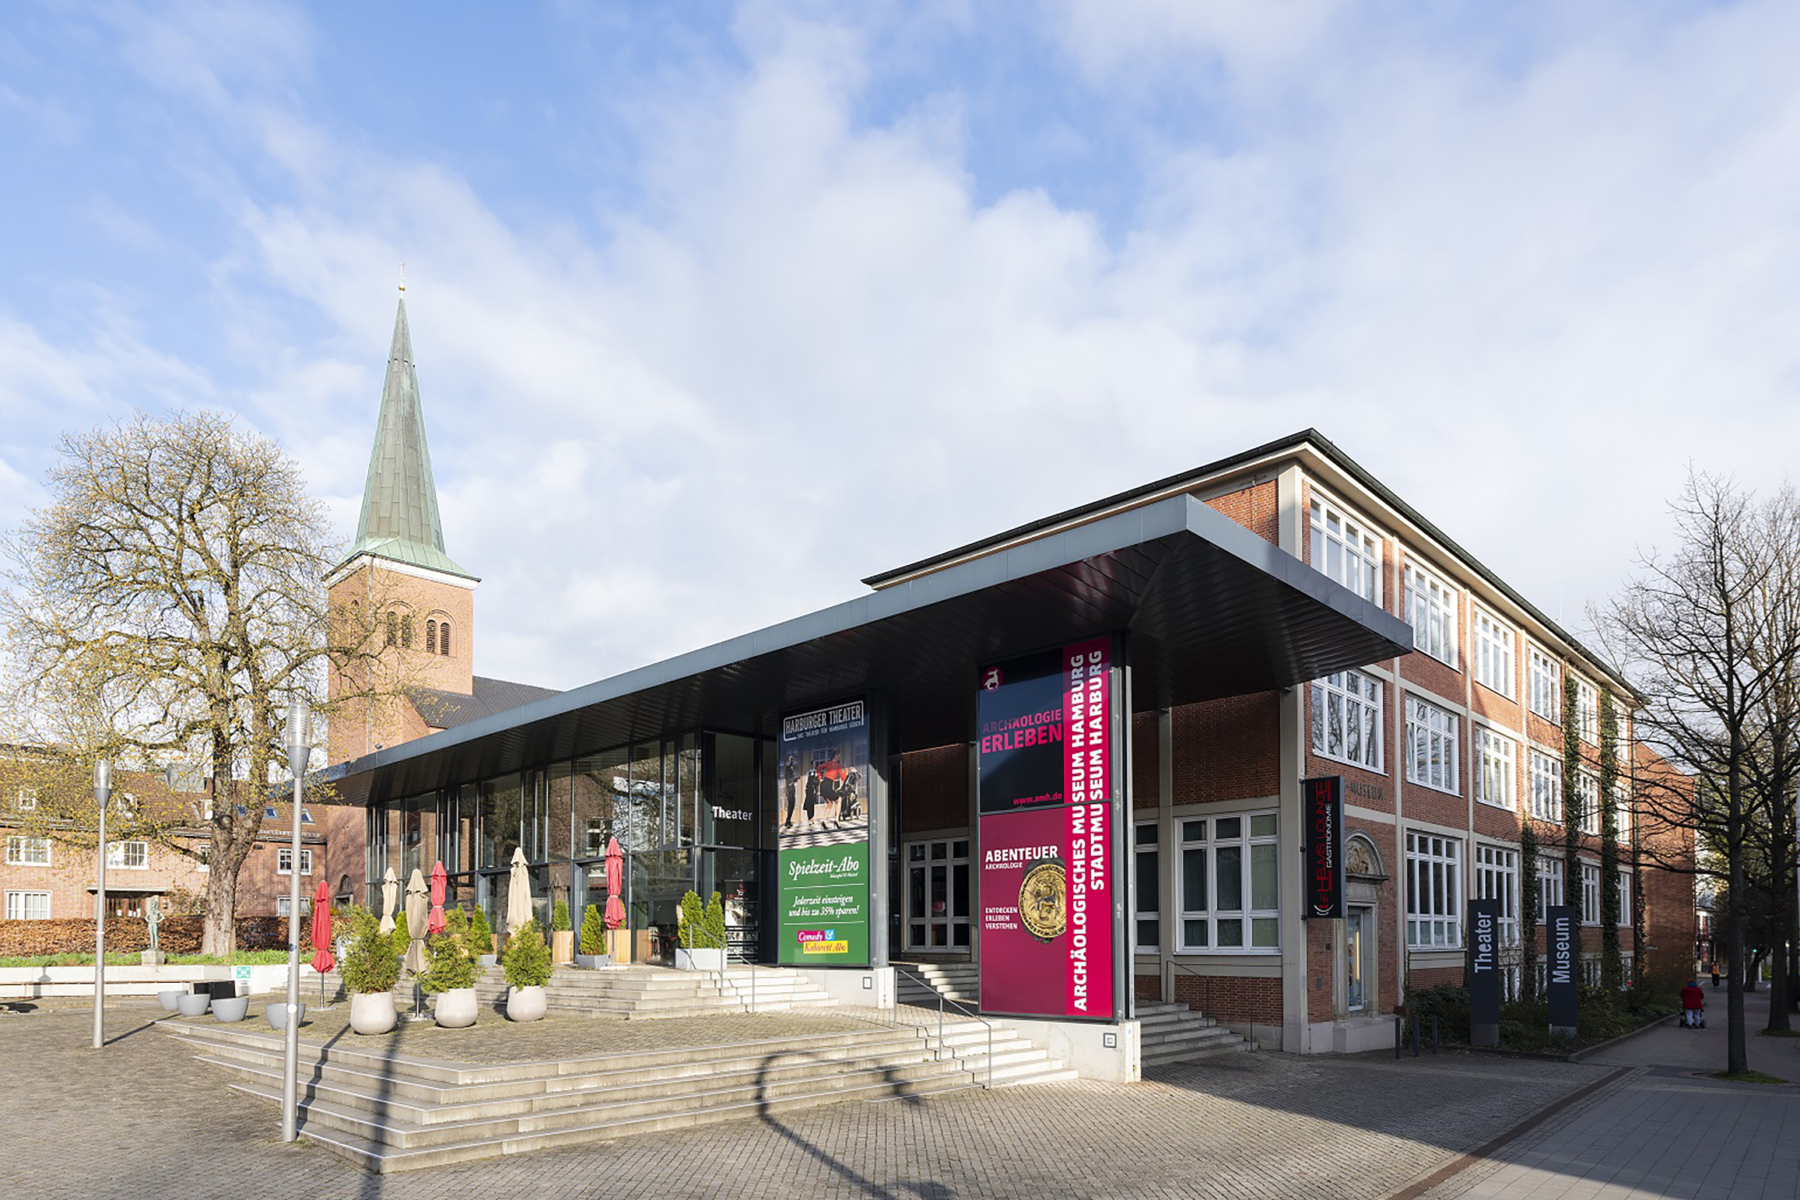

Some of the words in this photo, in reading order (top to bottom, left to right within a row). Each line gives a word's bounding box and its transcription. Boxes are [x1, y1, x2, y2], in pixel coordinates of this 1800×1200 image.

[1070, 654, 1085, 748] HAMBURG
[1088, 650, 1102, 744] HARBURG
[785, 712, 826, 734] HARBURGER
[828, 704, 860, 724] THEATER
[982, 709, 1062, 734] ARCHÄOLOGIE
[982, 723, 1062, 754] ERLEBEN
[1012, 791, 1062, 804] www.amh.de
[1071, 752, 1085, 834] MUSEUM
[712, 806, 752, 821] Theater
[1089, 749, 1104, 890] STADTMUSEUM
[1316, 782, 1328, 838] LOUNGE
[788, 856, 859, 880] Spielzeit-Abo
[985, 846, 1058, 862] ABENTEUER
[1316, 843, 1328, 892] HELMS
[788, 907, 801, 916] und
[801, 907, 810, 916] bis
[835, 905, 860, 918] sparen!
[792, 896, 821, 907] Jederzeit
[822, 894, 853, 906] einsteigen
[798, 931, 823, 943] Comedy
[1070, 838, 1087, 1011] ARCHÄOLOGISCHES
[804, 942, 832, 952] Kabarett
[832, 942, 846, 951] Abo
[1474, 912, 1492, 973] Theater
[1553, 917, 1570, 983] Museum
